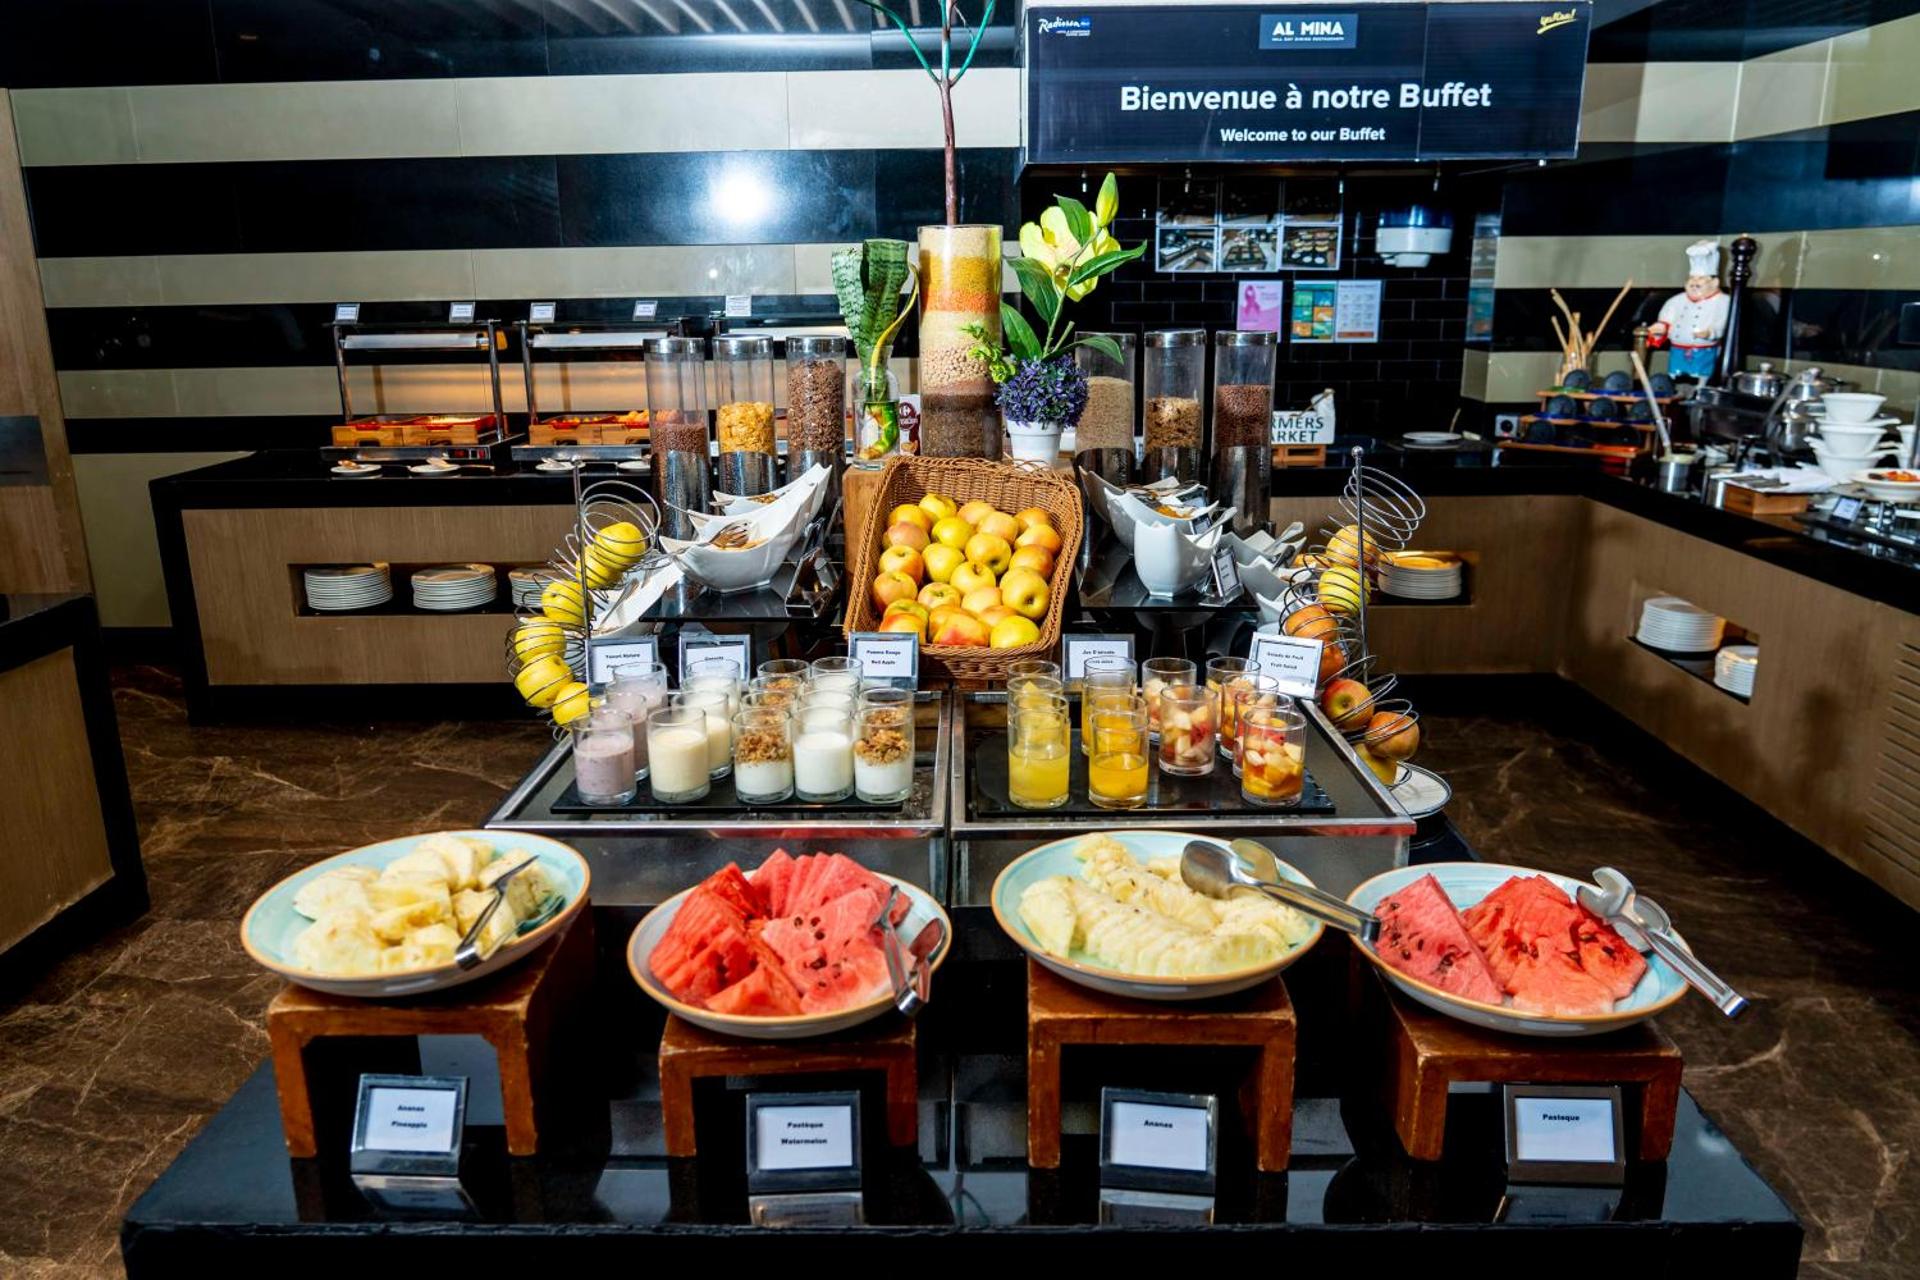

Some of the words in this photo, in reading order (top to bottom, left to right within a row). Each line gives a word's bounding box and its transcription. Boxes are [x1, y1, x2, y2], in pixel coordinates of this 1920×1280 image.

[1272, 21, 1295, 35] AL
[1300, 21, 1344, 35] MINA
[1120, 86, 1277, 111] Bienvenue
[1285, 83, 1303, 110] à
[1312, 86, 1391, 109] notre
[1399, 82, 1492, 109] Buffet
[1220, 128, 1288, 142] Welcome
[1291, 129, 1307, 142] to
[1310, 130, 1336, 141] our
[1339, 127, 1386, 141] Buffet
[397, 1104, 425, 1112] Ananas
[391, 1120, 428, 1128] Pineapple
[1144, 1119, 1174, 1128] Ananas
